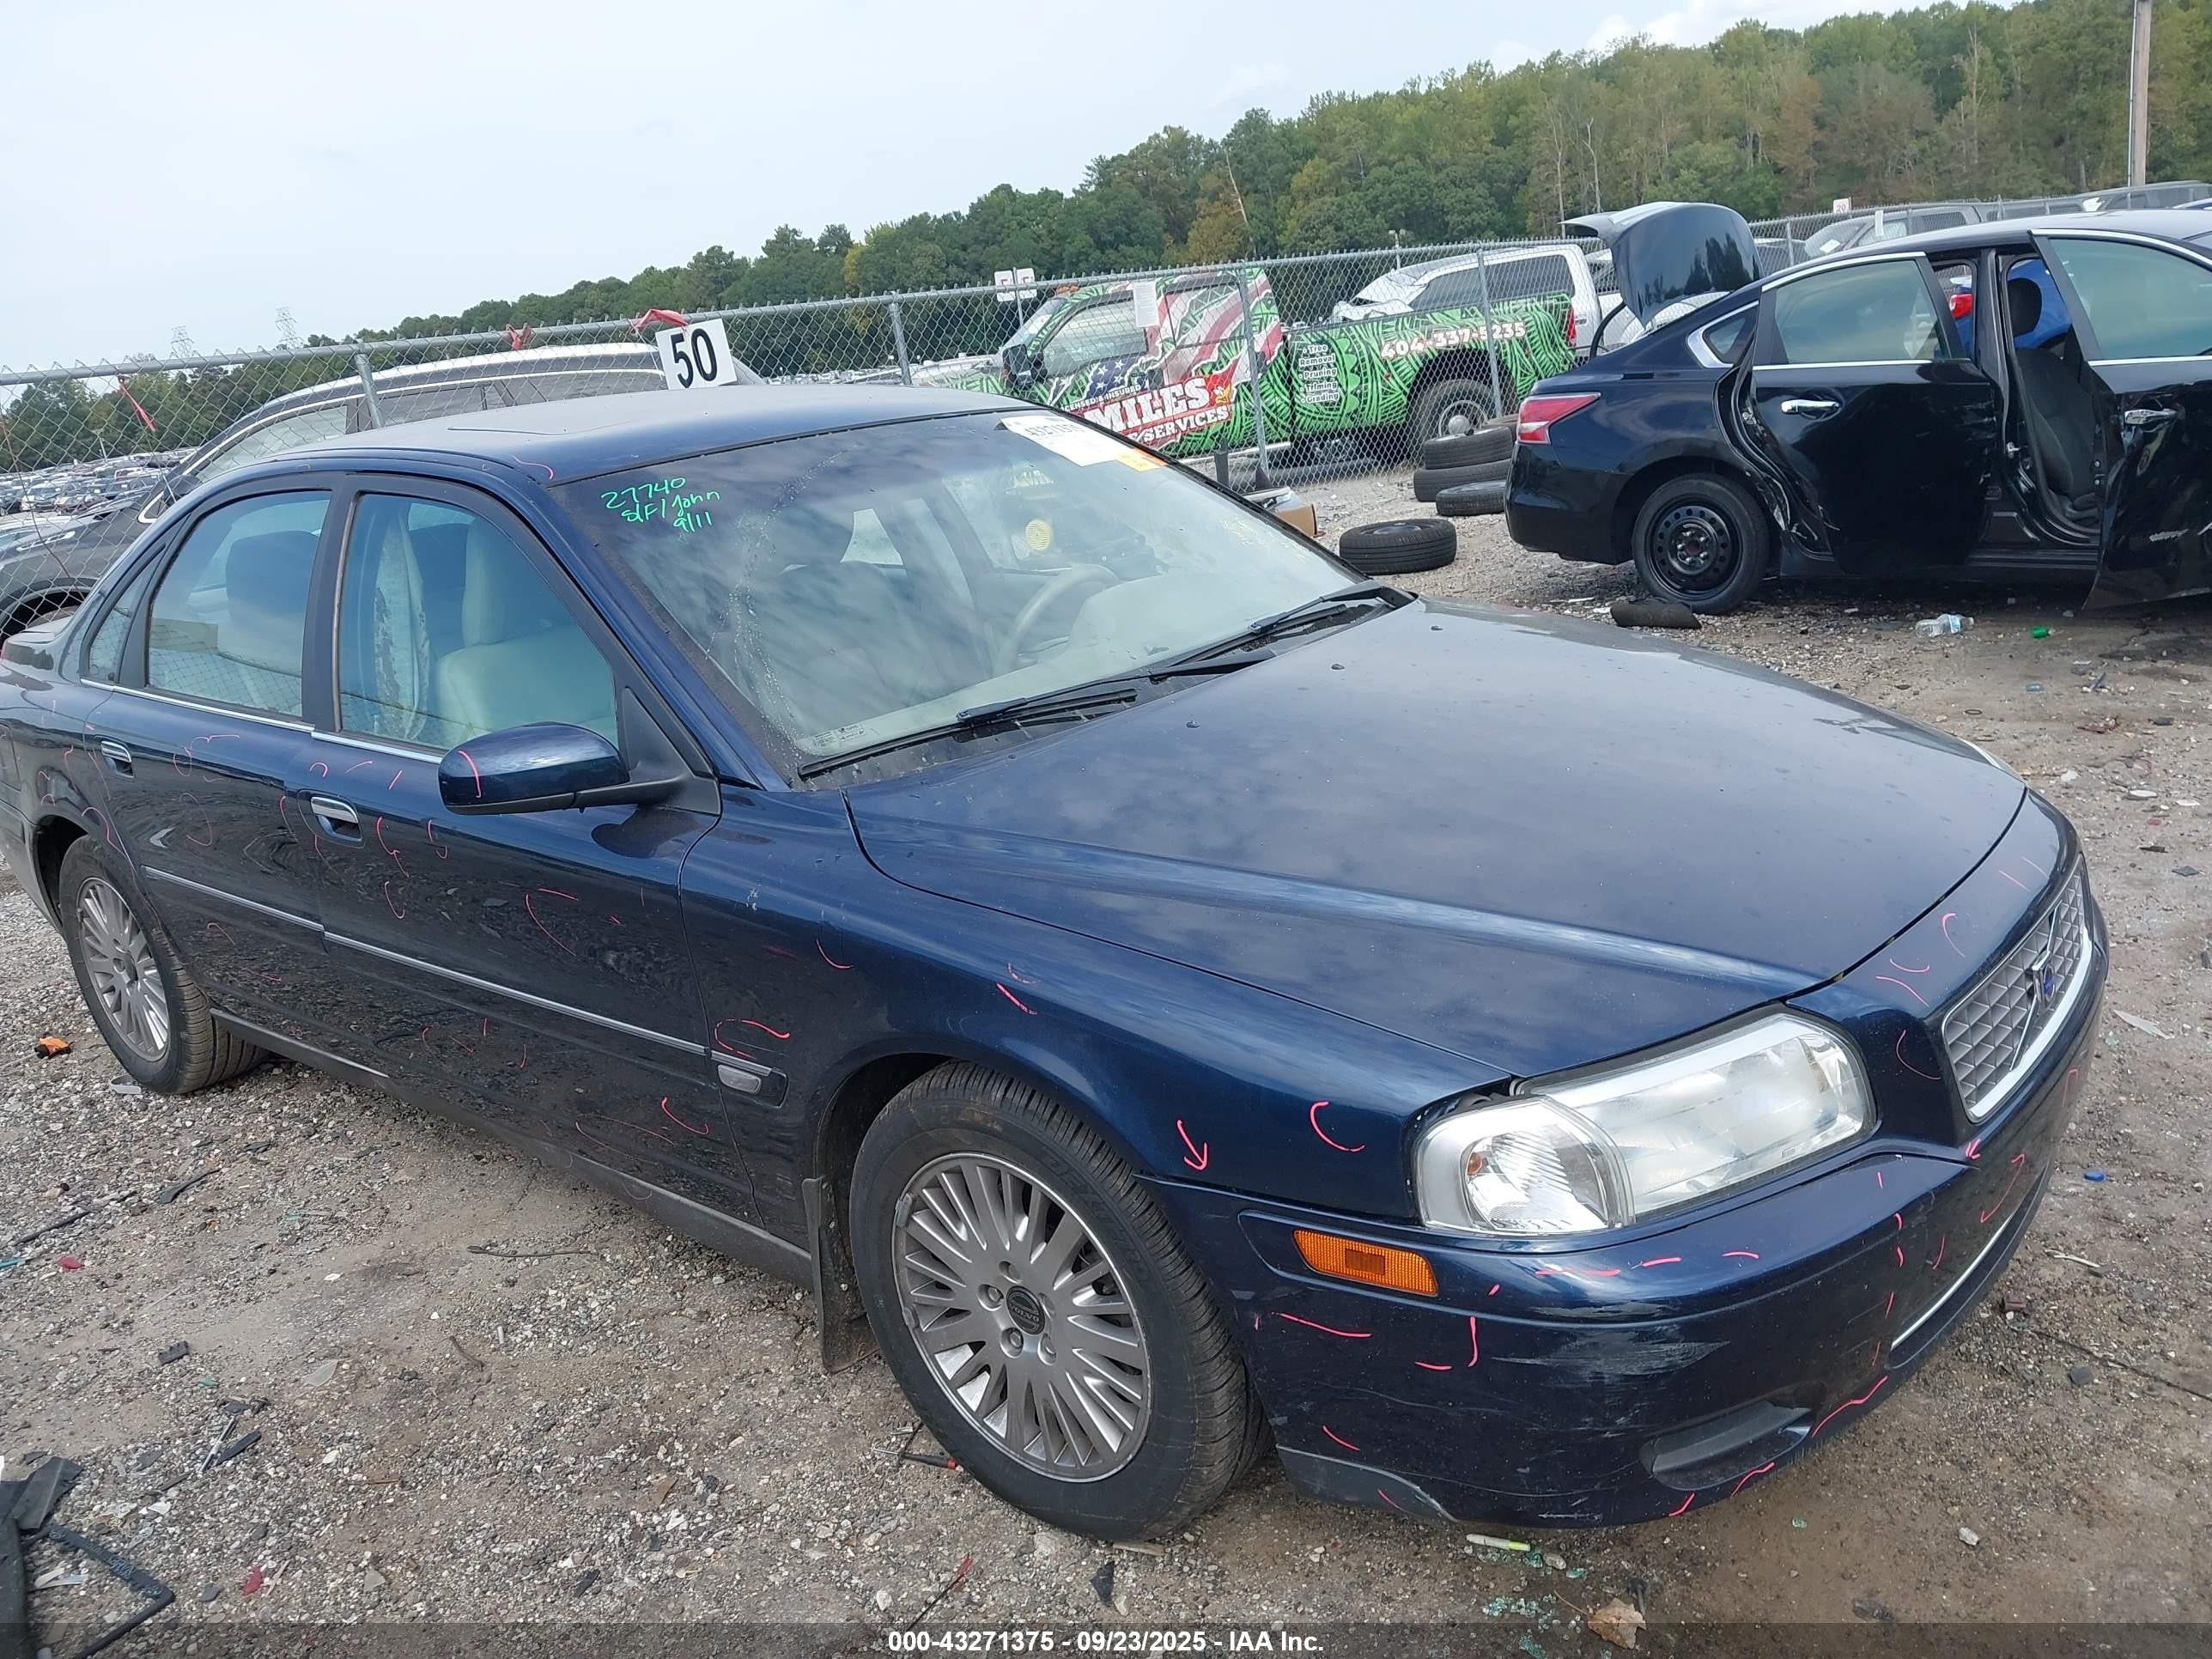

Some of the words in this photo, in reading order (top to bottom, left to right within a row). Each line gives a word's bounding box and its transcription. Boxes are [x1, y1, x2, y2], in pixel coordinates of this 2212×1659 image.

[671, 327, 718, 388] 50
[1381, 321, 1527, 359] 404-337-5235
[1298, 353, 1336, 367] Removal
[1304, 368, 1337, 380] Pruning
[1084, 378, 1210, 431] MILES
[600, 477, 686, 509] 27740
